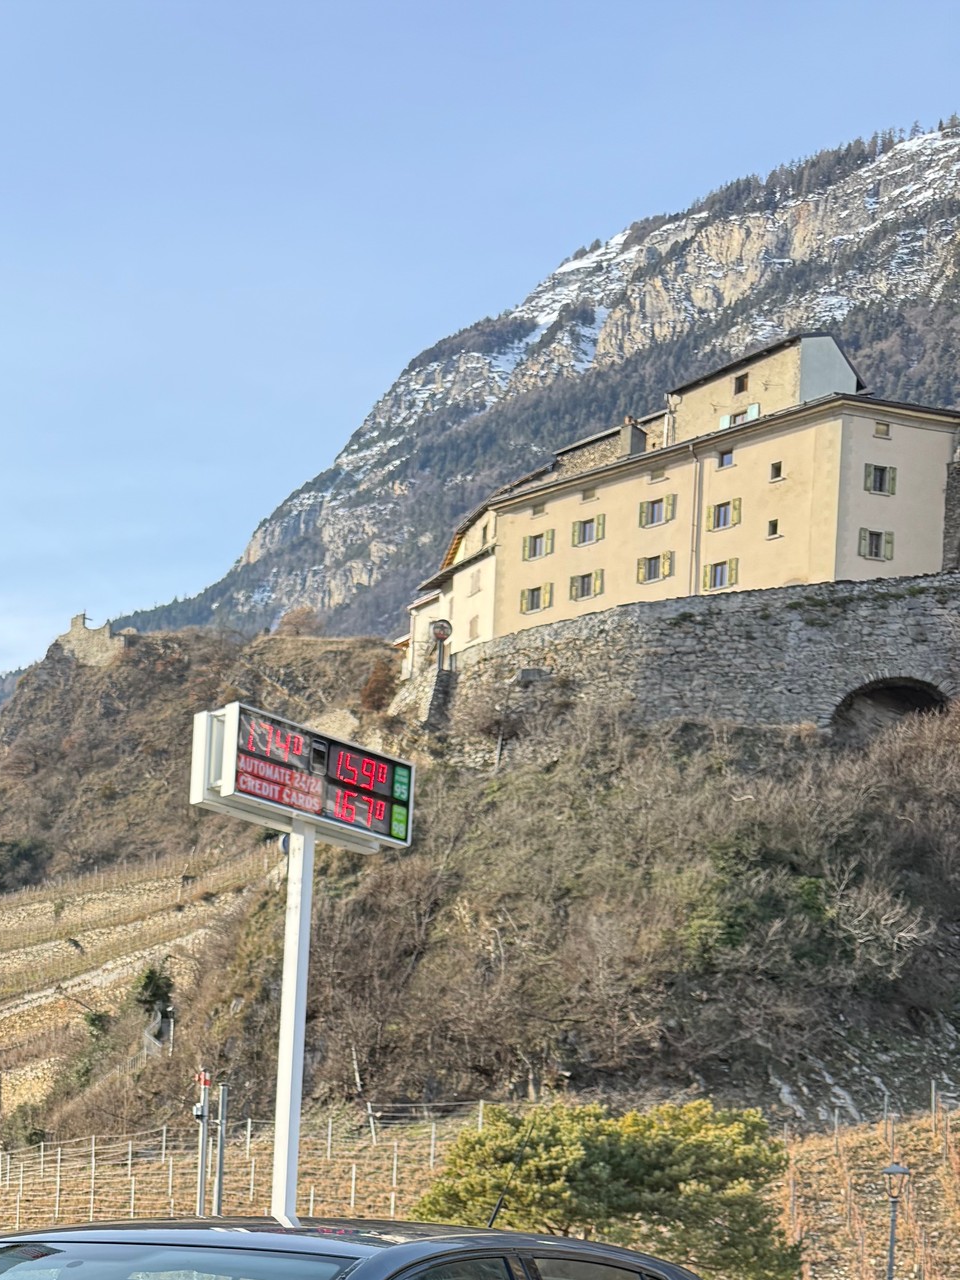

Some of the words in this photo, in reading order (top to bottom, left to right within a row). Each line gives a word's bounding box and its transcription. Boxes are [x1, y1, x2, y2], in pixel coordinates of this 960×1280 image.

[239, 755, 291, 785] AUTOMATE
[293, 773, 323, 797] 24/24
[239, 775, 280, 799] CREDIT
[282, 787, 320, 812] CARDS
[393, 783, 409, 800] 95
